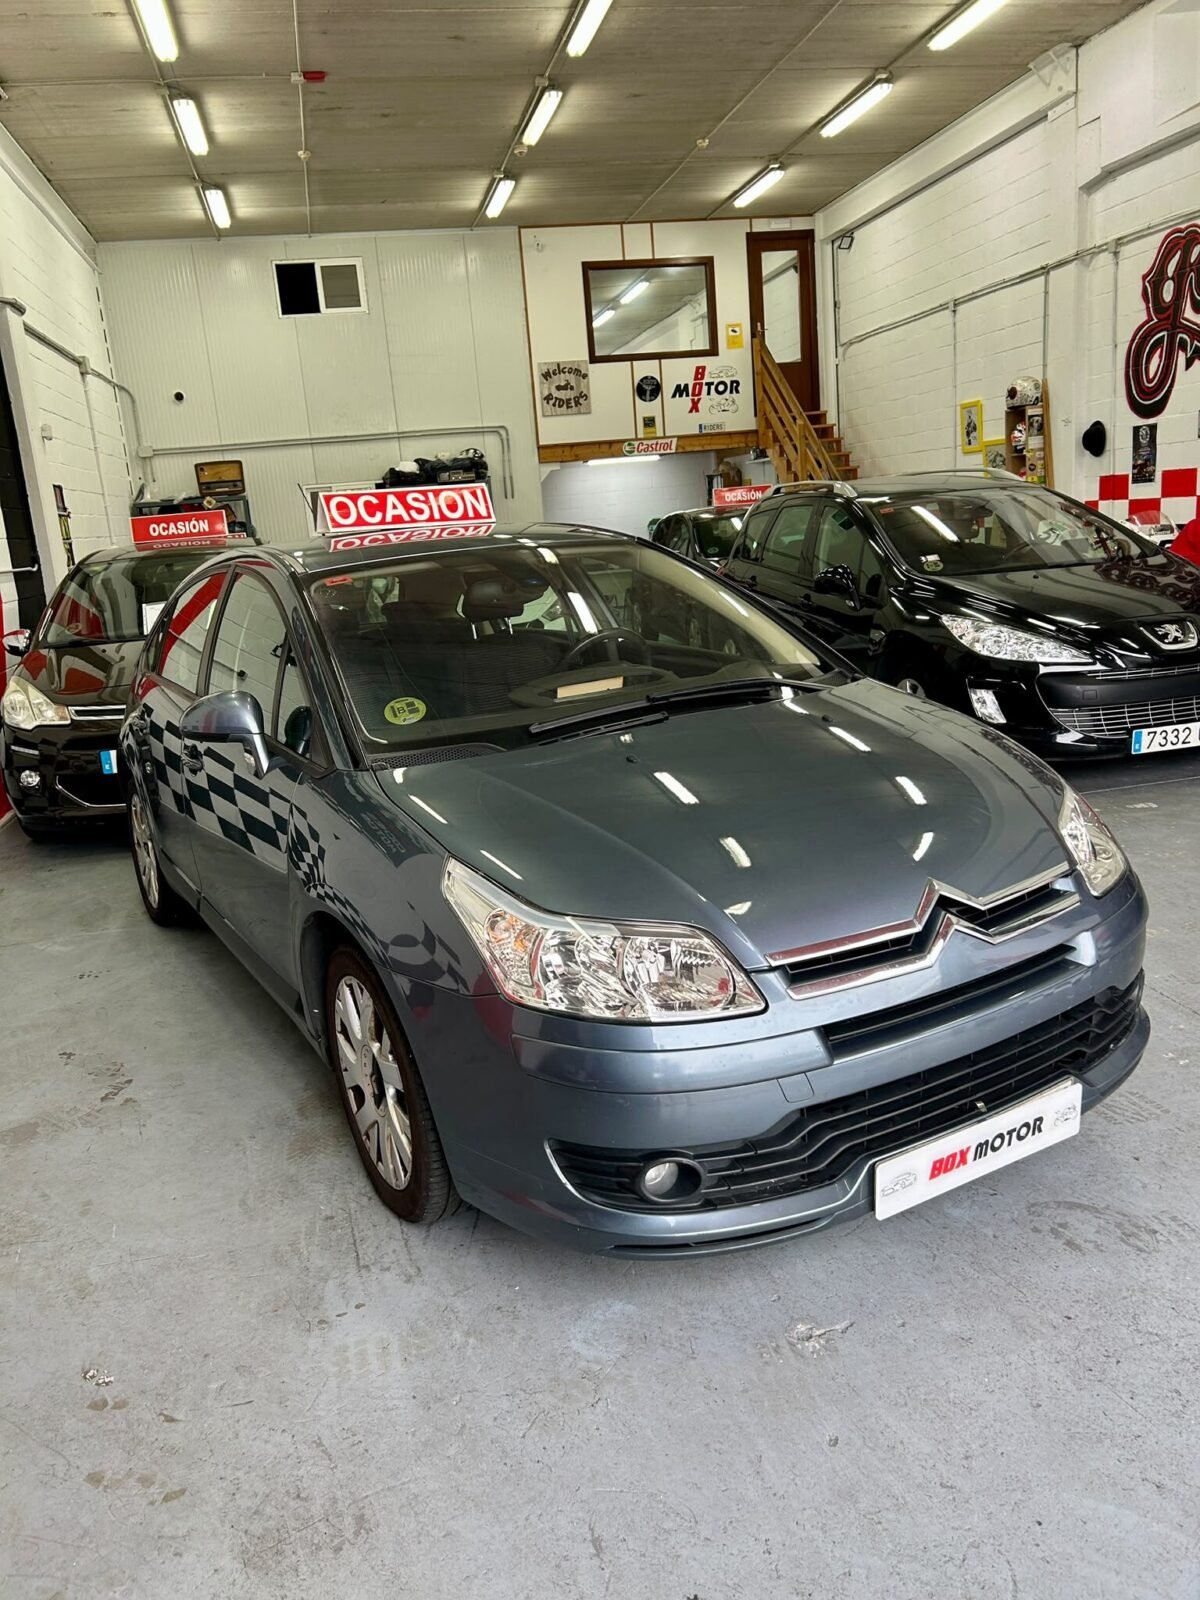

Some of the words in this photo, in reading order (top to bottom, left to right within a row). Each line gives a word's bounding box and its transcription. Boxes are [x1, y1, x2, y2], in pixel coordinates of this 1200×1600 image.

[541, 362, 588, 381] Welcome
[671, 380, 740, 399] MOTOR
[688, 365, 706, 413] BOX
[543, 391, 588, 410] RIDERS
[703, 423, 723, 431] RIDERS
[636, 440, 673, 454] Castrol
[725, 489, 762, 502] OCASIÓN
[329, 486, 488, 525] OCASION
[149, 517, 209, 536] OCASIÓN
[1147, 726, 1192, 749] 7332
[928, 1145, 971, 1181] BOX
[972, 1116, 1044, 1162] MOTOR
